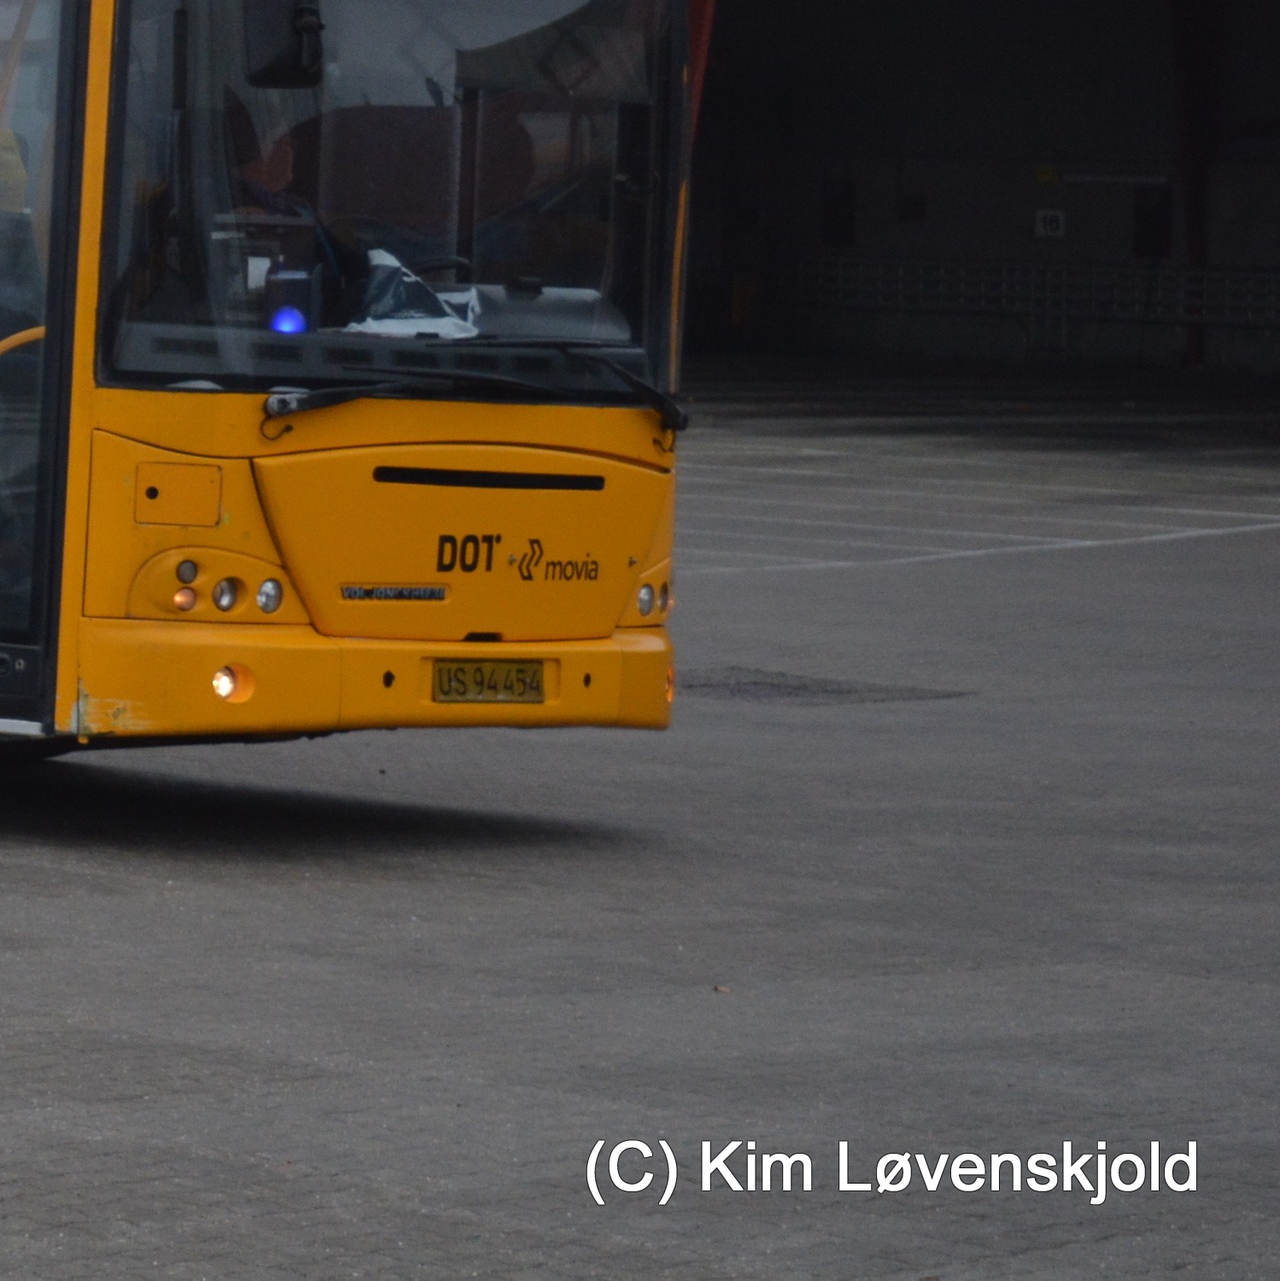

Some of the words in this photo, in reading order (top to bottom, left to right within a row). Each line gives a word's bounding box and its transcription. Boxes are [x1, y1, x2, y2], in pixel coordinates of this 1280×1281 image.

[436, 534, 501, 573] DOT
[544, 552, 599, 581] movia
[438, 666, 468, 696] US
[473, 666, 499, 696] 94
[503, 667, 541, 697] 454
